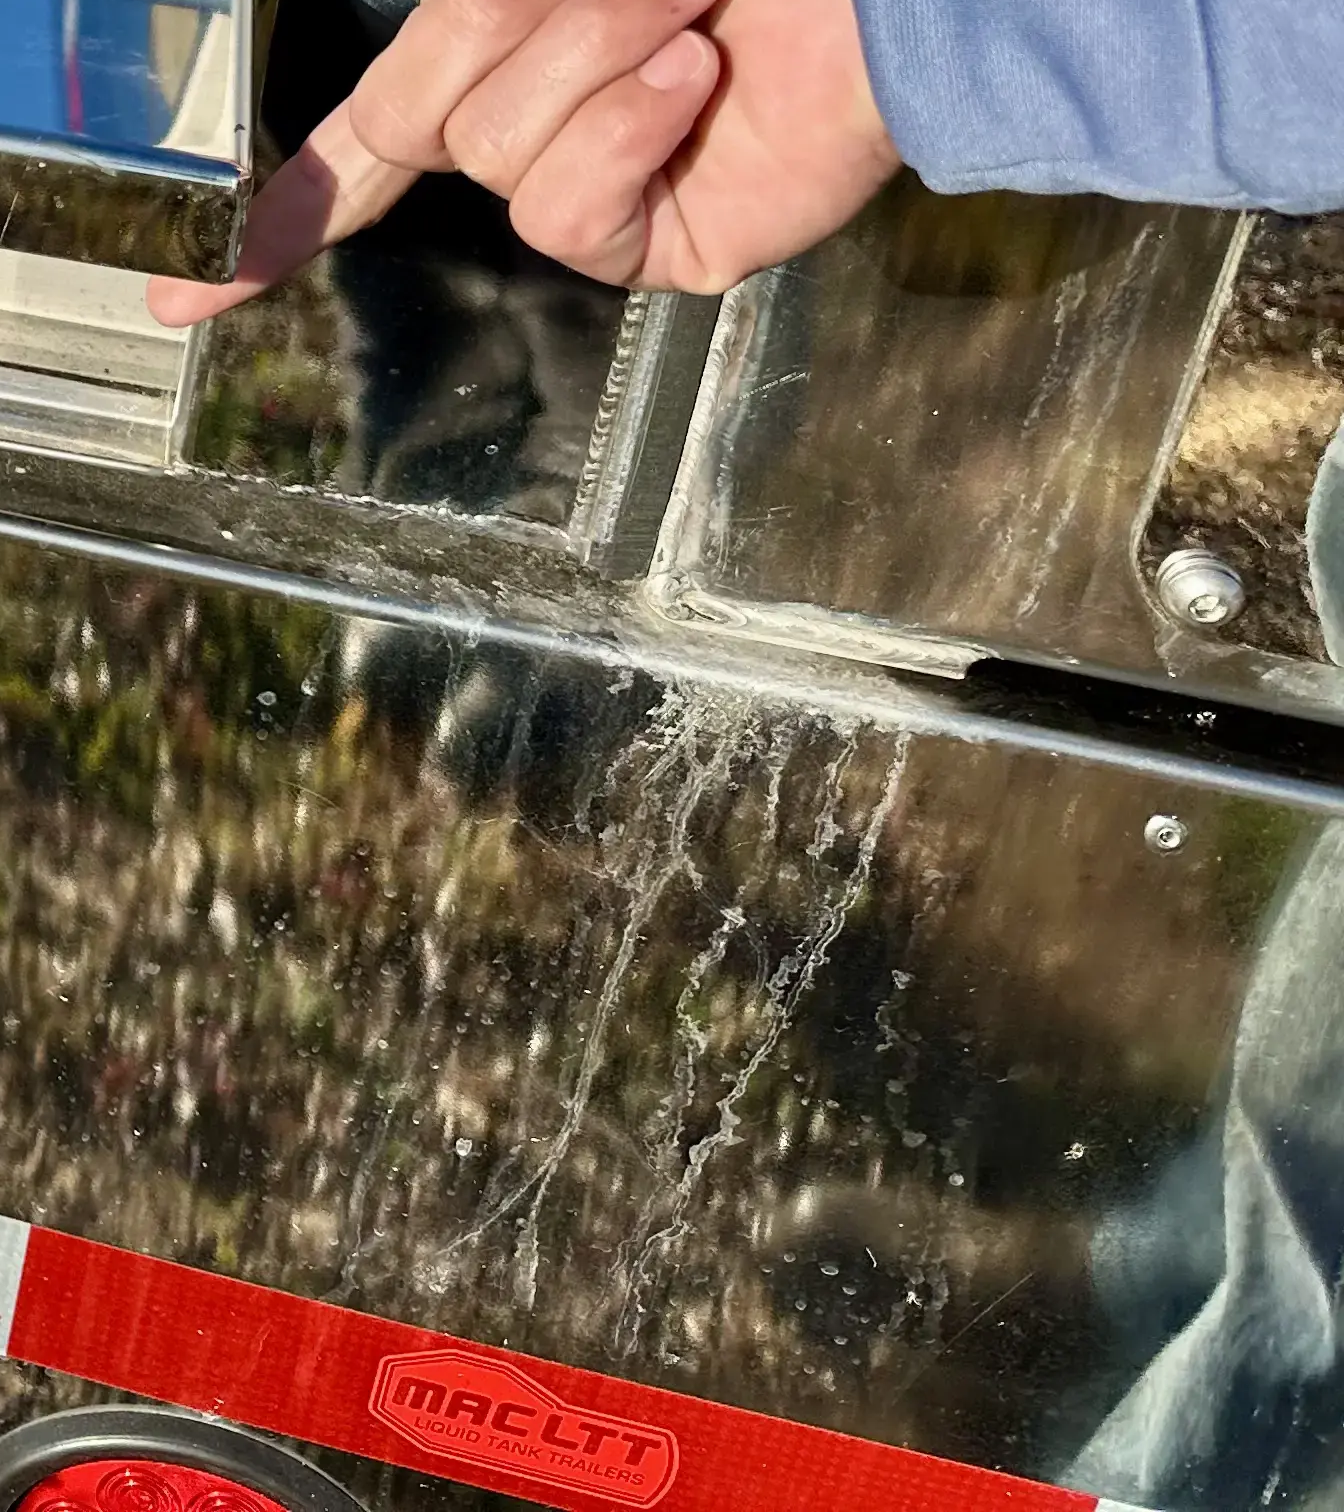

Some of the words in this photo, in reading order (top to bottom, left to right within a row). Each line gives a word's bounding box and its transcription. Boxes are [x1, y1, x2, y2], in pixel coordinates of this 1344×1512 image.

[391, 1375, 538, 1437] MAC
[542, 1414, 663, 1468] LTT
[413, 1416, 480, 1444] LIQUID
[487, 1435, 543, 1460] TANK
[548, 1449, 646, 1487] TRAILERS
